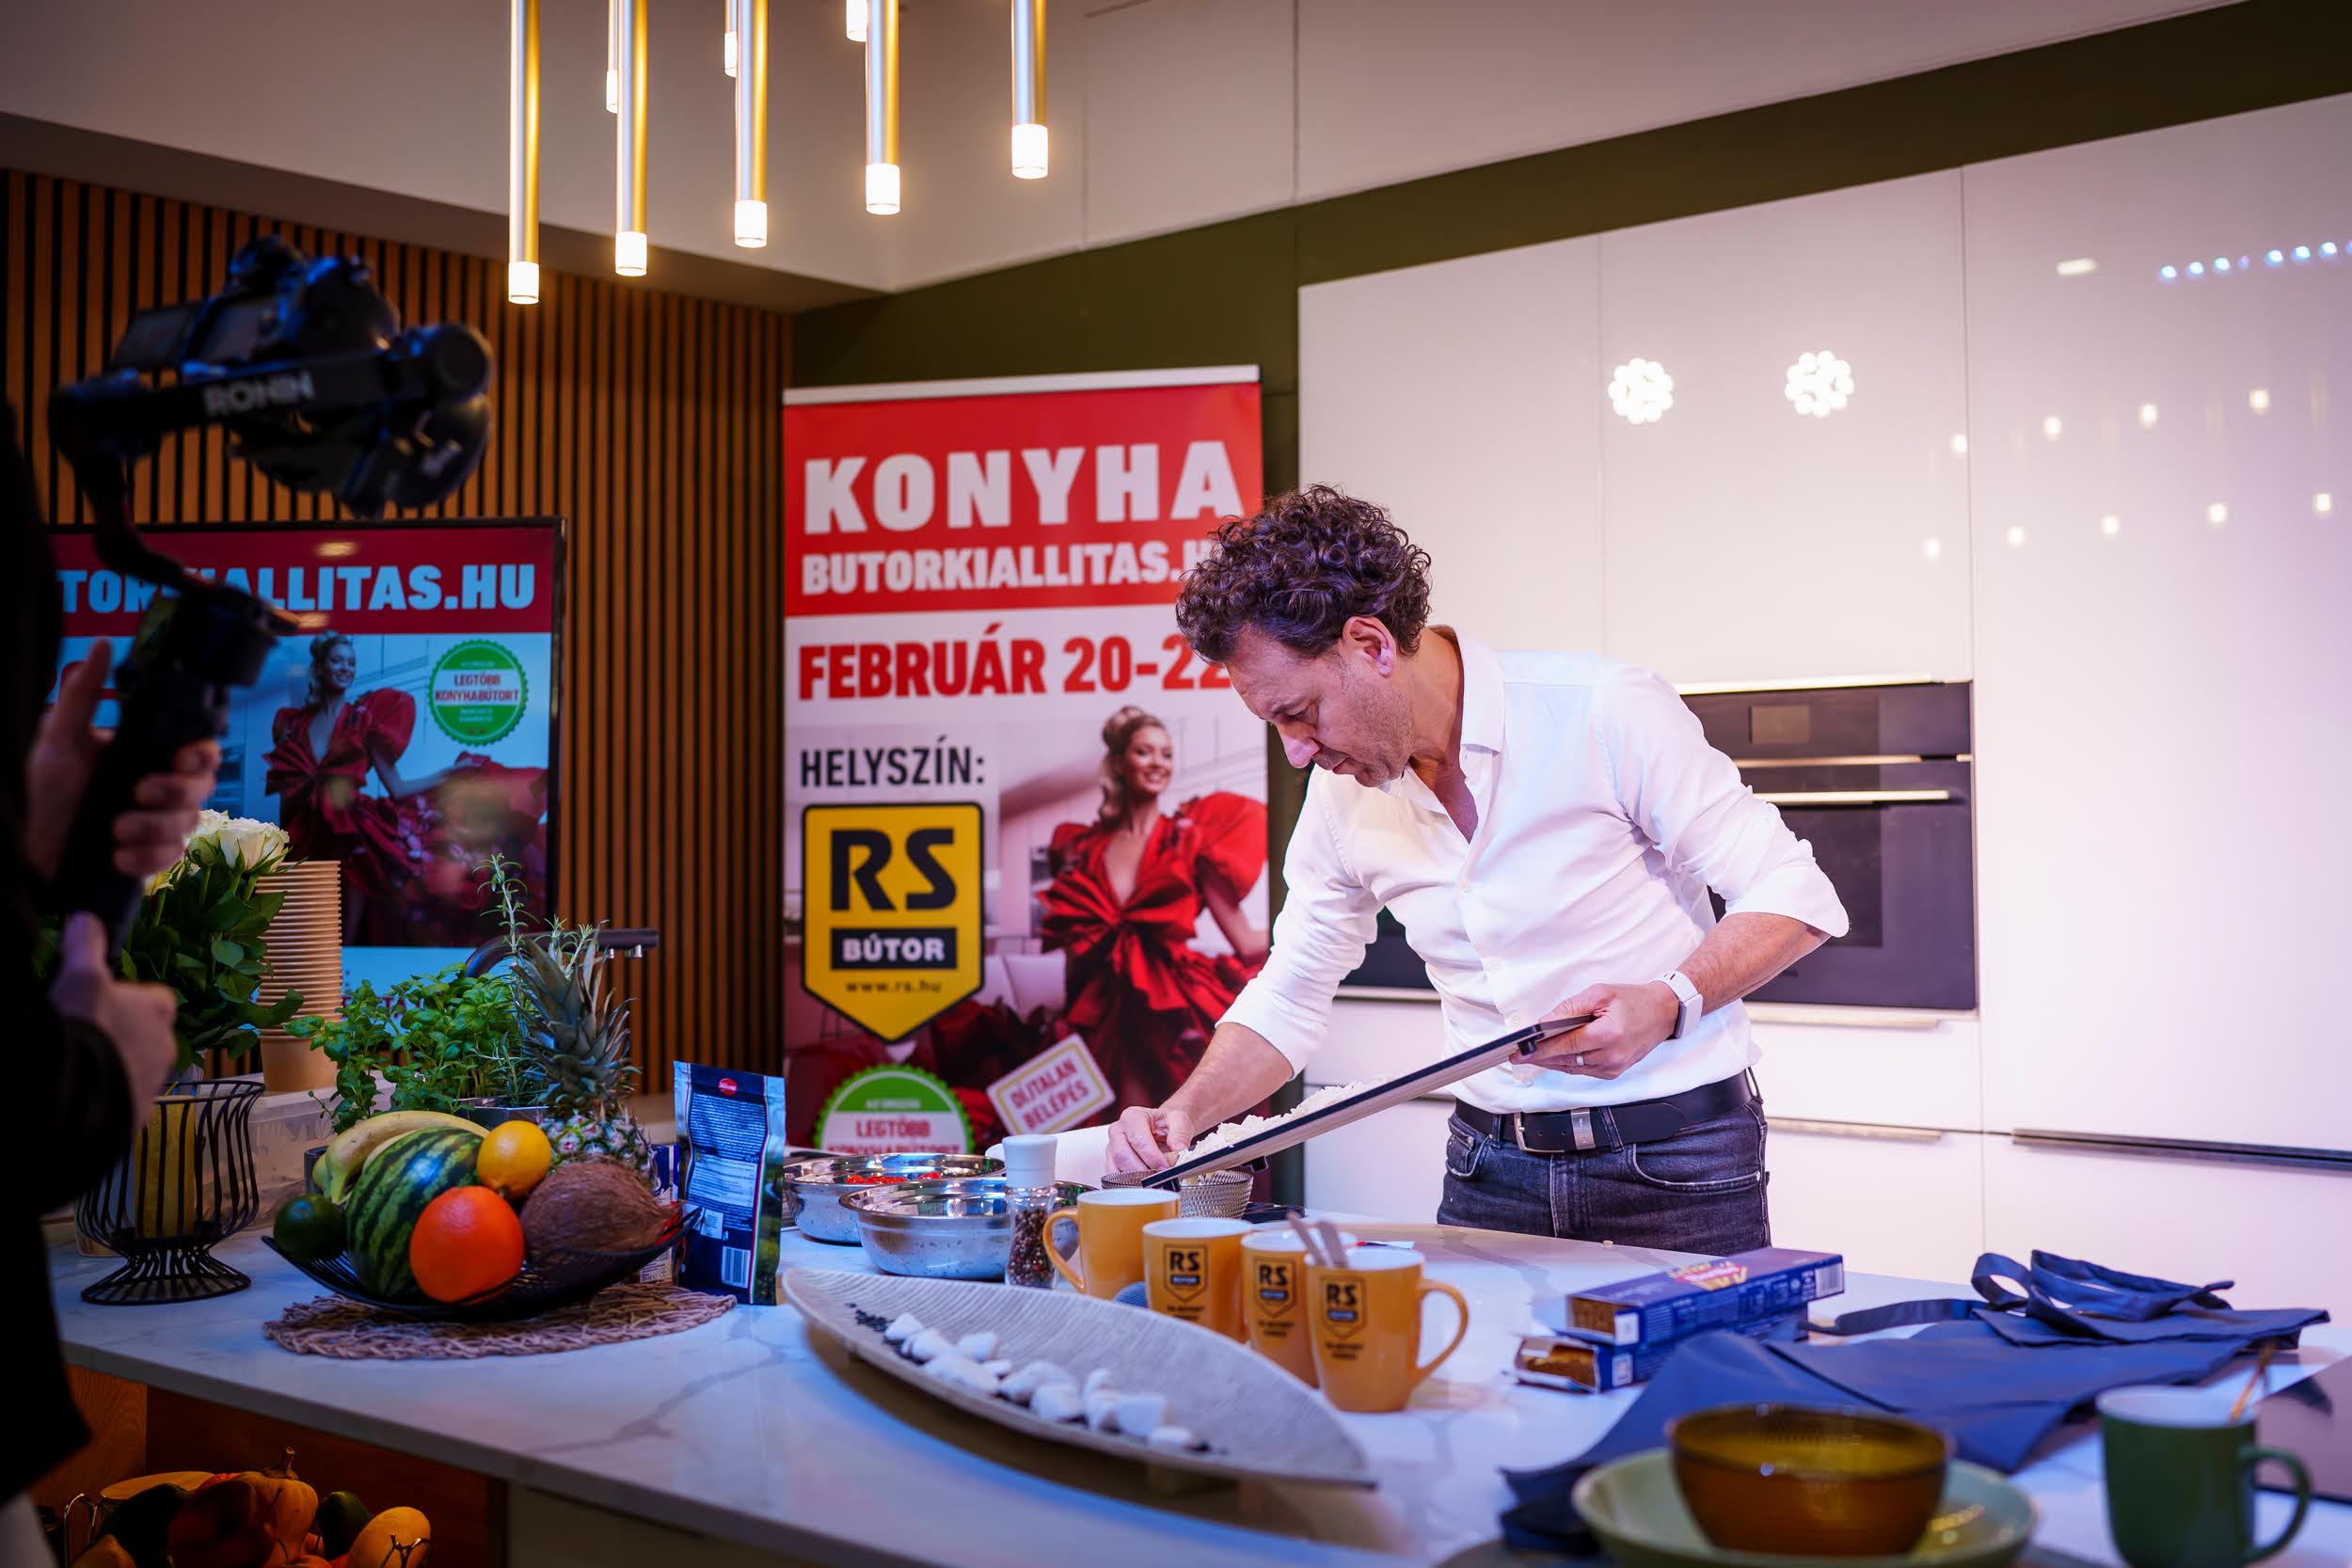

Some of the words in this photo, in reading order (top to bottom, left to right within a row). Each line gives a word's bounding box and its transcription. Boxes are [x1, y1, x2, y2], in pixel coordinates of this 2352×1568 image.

[202, 371, 314, 418] RONIN
[803, 440, 1245, 535] KONYHA
[798, 623, 1046, 701] FEBRUÁR
[801, 735, 985, 788] HELYSZÍN:
[830, 828, 958, 911] RS
[842, 932, 946, 961] BÚTOR
[845, 979, 942, 993] www.rs.hu
[1009, 1058, 1077, 1109] DÍJTALAN
[1023, 1079, 1089, 1130] BELÉPÉS
[1169, 1250, 1200, 1272] RS
[1259, 1264, 1288, 1287] RS
[1327, 1283, 1357, 1307] RS
